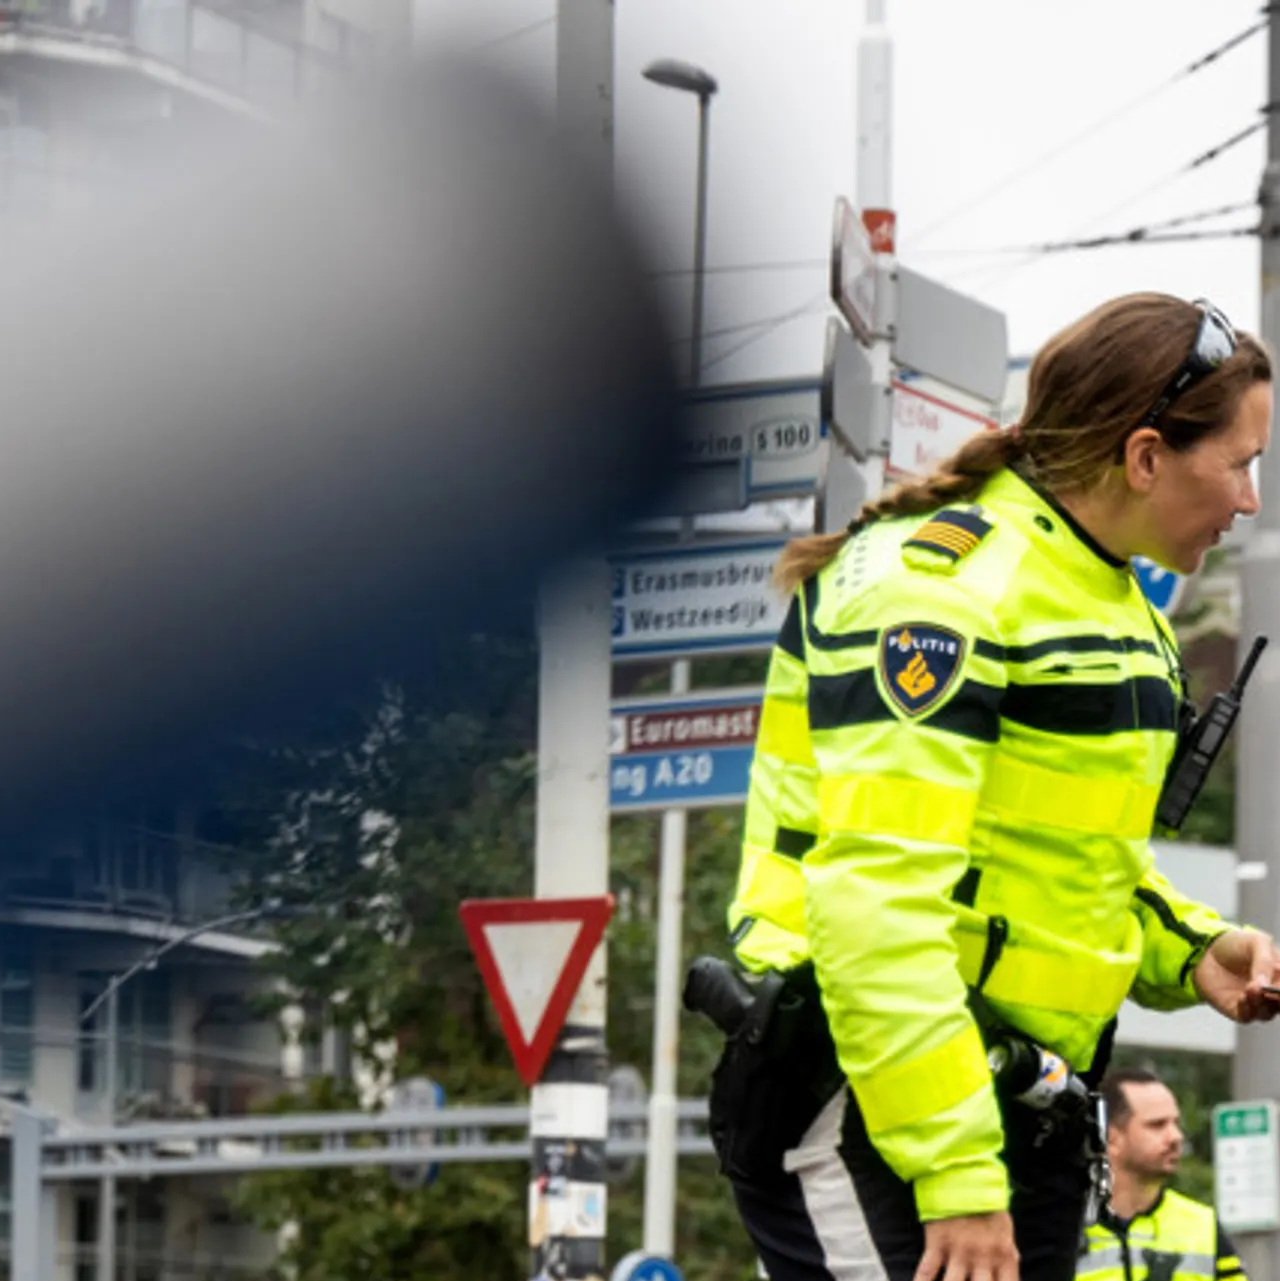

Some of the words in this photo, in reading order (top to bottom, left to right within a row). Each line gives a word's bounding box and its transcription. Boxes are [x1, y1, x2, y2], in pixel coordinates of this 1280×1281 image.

[756, 429, 769, 450] S
[774, 423, 811, 449] 100
[631, 560, 774, 596] Erasmusbru
[630, 600, 769, 633] Westzeedijk
[887, 634, 958, 656] POLITIE
[630, 709, 755, 746] Euromast
[612, 763, 648, 797] ng
[653, 752, 714, 788] A20
